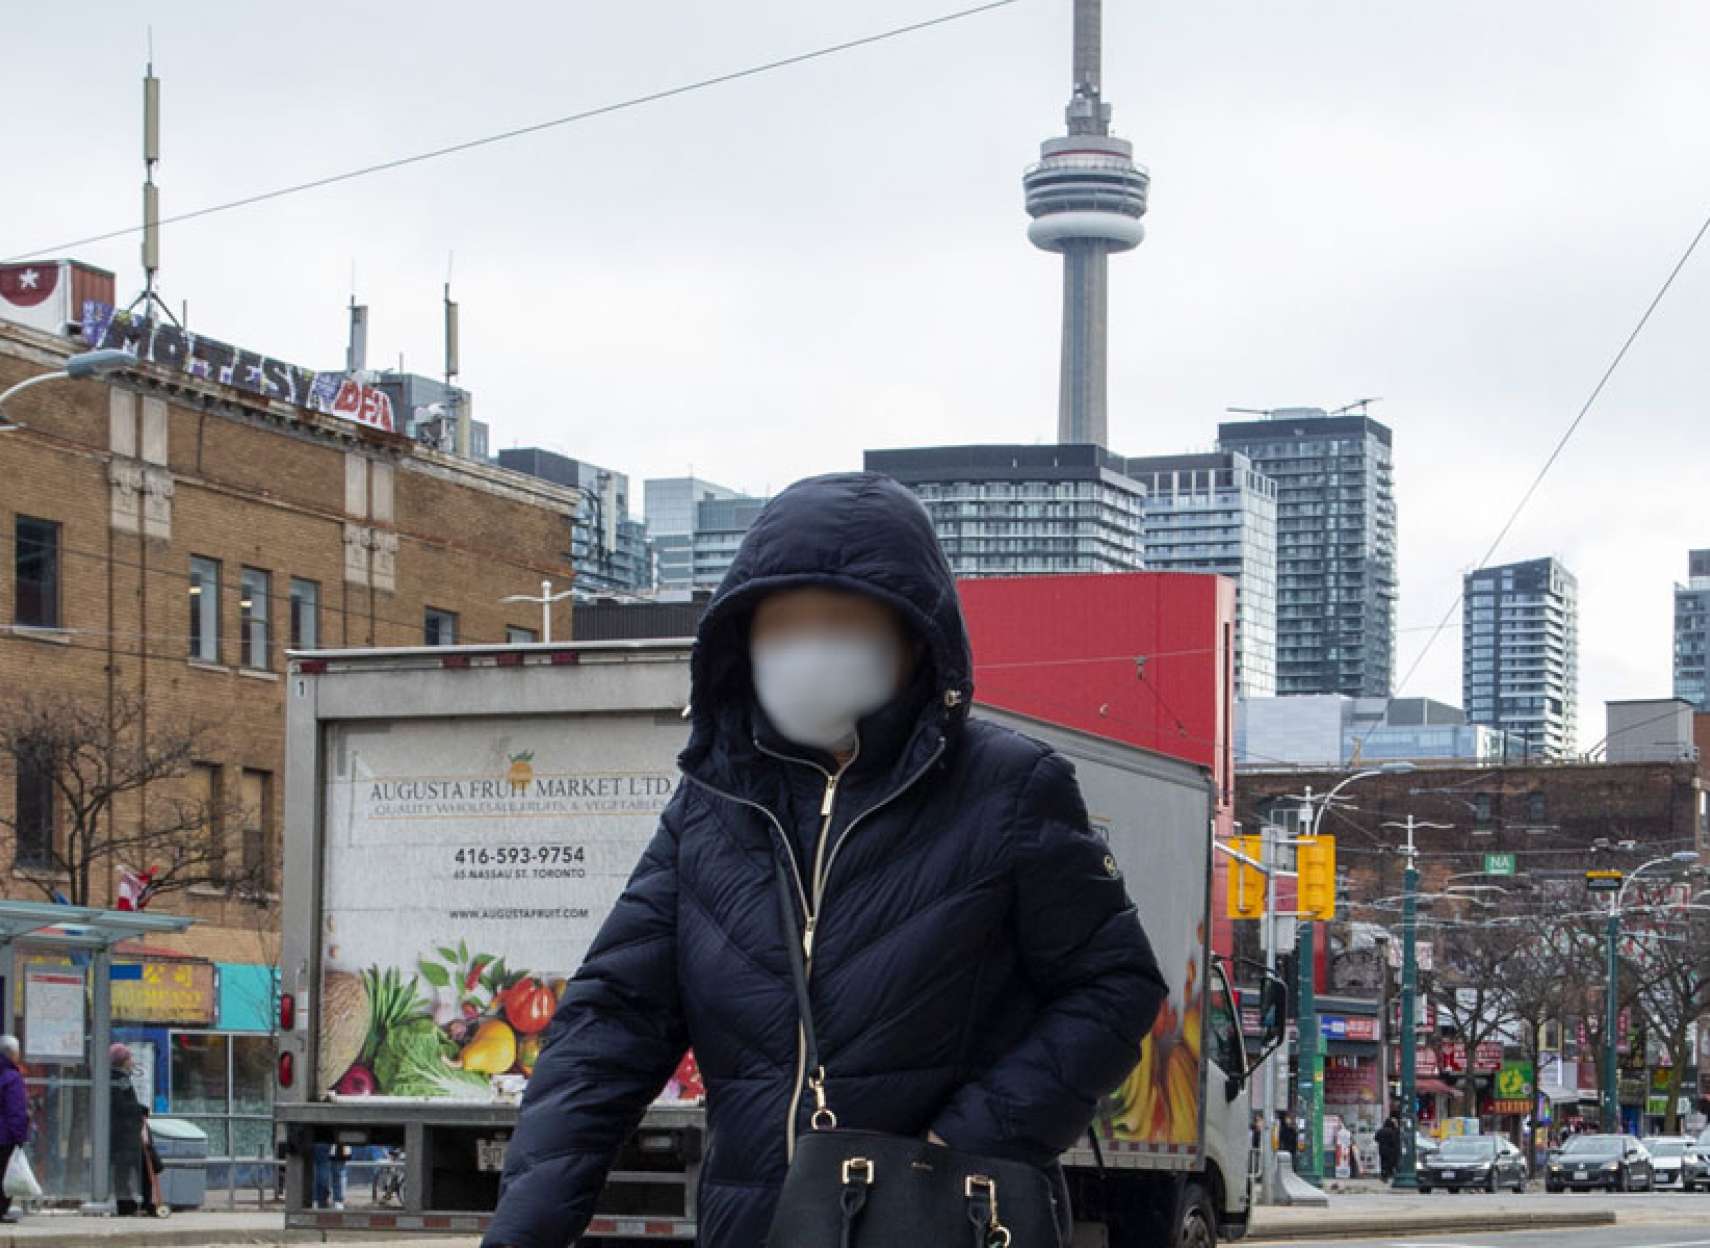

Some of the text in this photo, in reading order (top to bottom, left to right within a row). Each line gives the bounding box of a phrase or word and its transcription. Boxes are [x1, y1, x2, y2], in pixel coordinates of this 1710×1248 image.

[370, 780, 464, 801] AUGUSTA
[469, 778, 529, 799] FRUIT
[535, 777, 624, 798] MARKET
[374, 802, 433, 817] QUALITY
[454, 845, 585, 865] 416-593-9754
[468, 868, 513, 879] NASSAU
[532, 867, 586, 879] TORONTO
[448, 907, 589, 919] WWW.AUGUSTAFRUIT.COM
